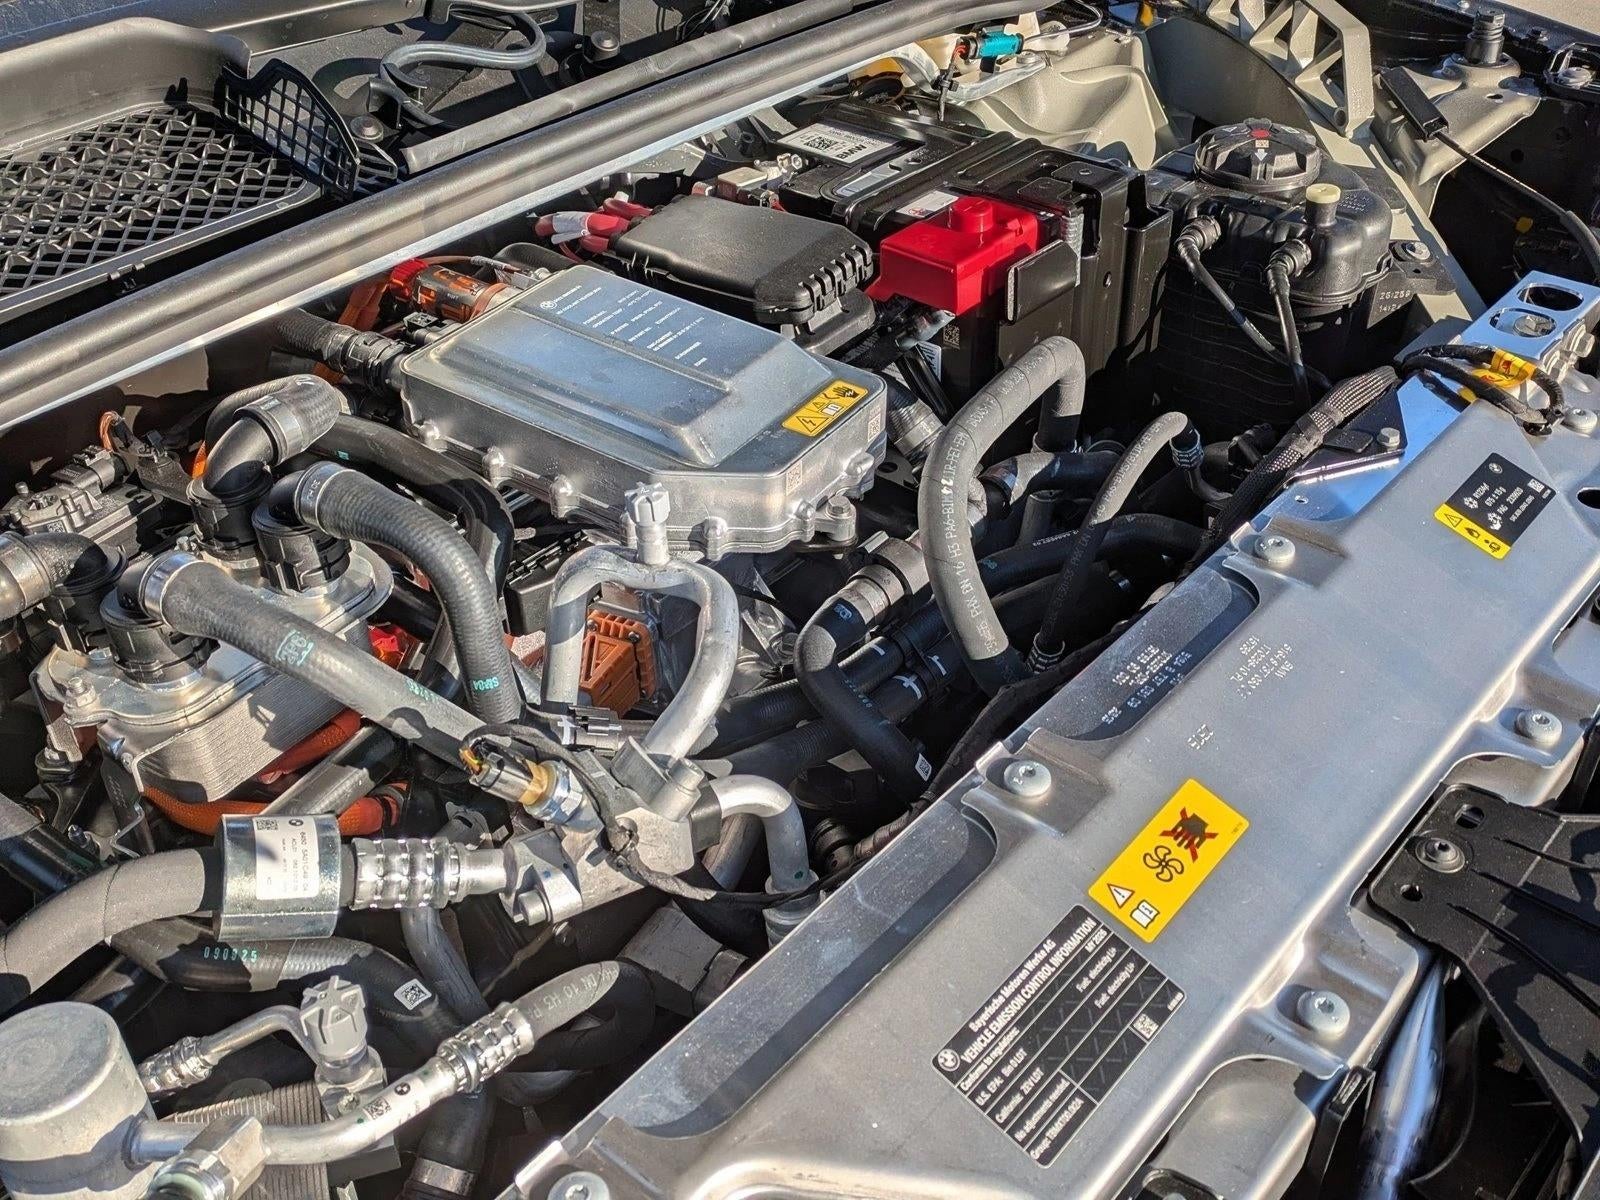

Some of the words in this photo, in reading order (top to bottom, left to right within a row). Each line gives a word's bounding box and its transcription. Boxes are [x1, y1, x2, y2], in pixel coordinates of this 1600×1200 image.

[835, 144, 867, 159] BMW
[1084, 940, 1097, 953] MY
[1091, 927, 1108, 945] 2026
[960, 1027, 995, 1065] VEHICLE
[988, 992, 1027, 1035] EMISSION
[1019, 960, 1056, 1000] CONTROL
[1048, 915, 1097, 968] INFORMATION
[967, 992, 1006, 1034] Bayerische
[999, 966, 1030, 999] Motoren
[1024, 947, 1048, 972] Werke
[1042, 938, 1057, 953] AG
[1074, 975, 1092, 993] Fuel:
[1086, 952, 1112, 981] electricity
[1093, 990, 1110, 1009] Fuel:
[1104, 968, 1131, 997] electricity
[959, 1060, 988, 1092] Conforms
[983, 1054, 994, 1066] to
[975, 1089, 991, 1106] U.S.
[1013, 1047, 1028, 1063] LDT
[1019, 1078, 1035, 1095] ZEV
[1029, 1066, 1045, 1083] LDT
[1013, 1127, 1027, 1142] No
[1021, 1096, 1054, 1134] adjustments
